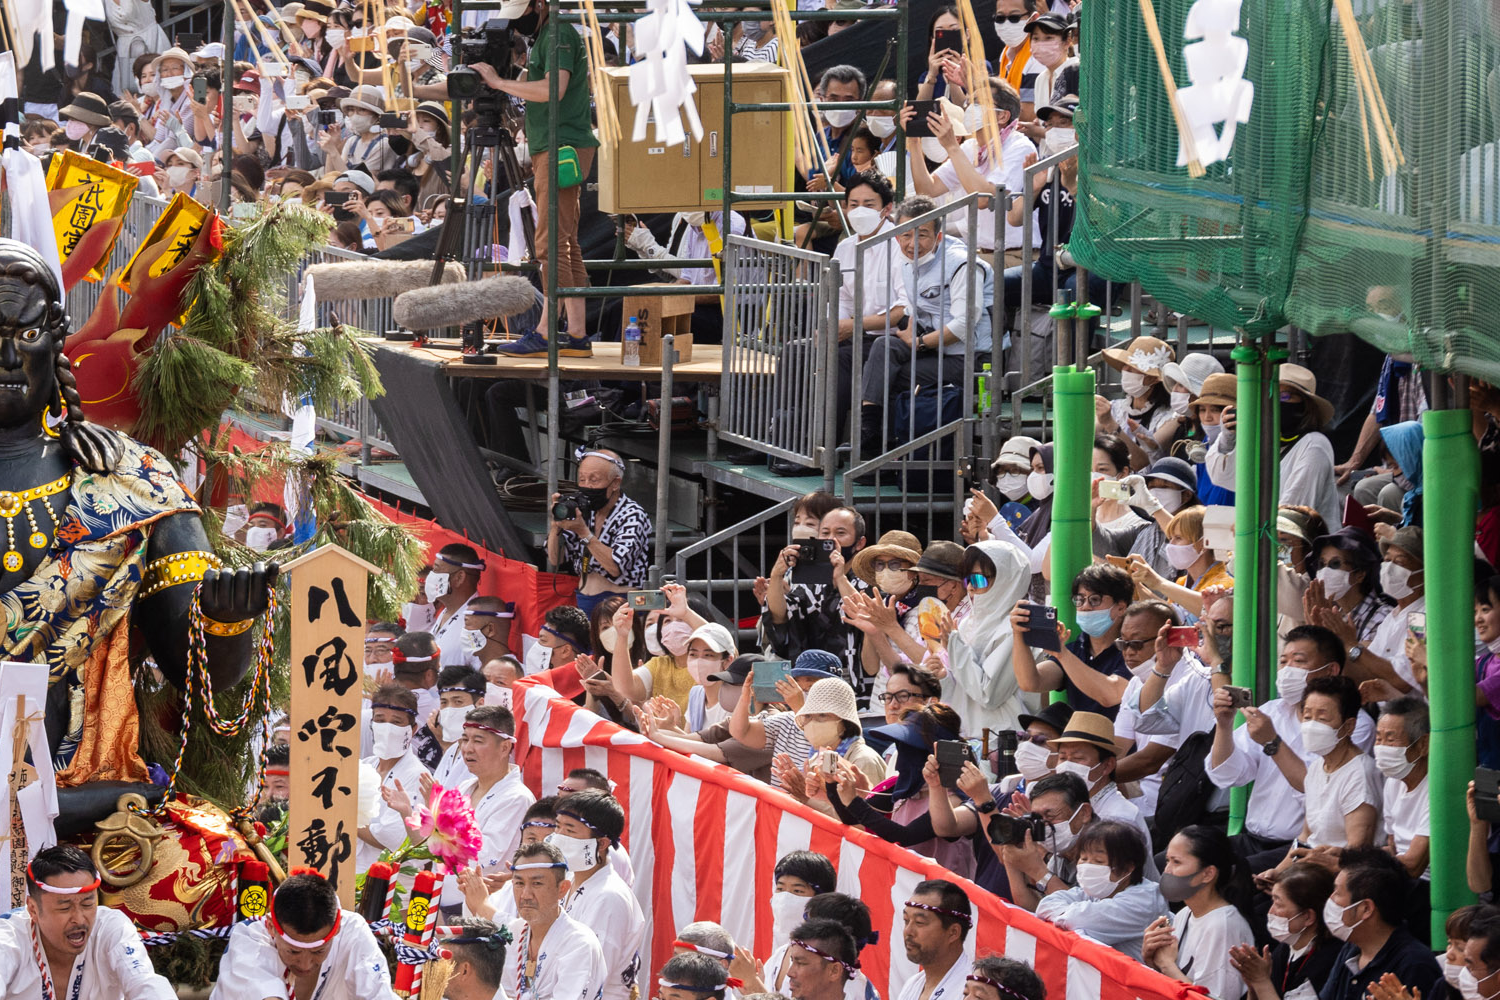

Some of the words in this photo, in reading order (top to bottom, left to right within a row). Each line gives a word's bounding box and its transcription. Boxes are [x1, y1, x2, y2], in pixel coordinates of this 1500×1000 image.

[296, 576, 362, 892] 八風吹不動
